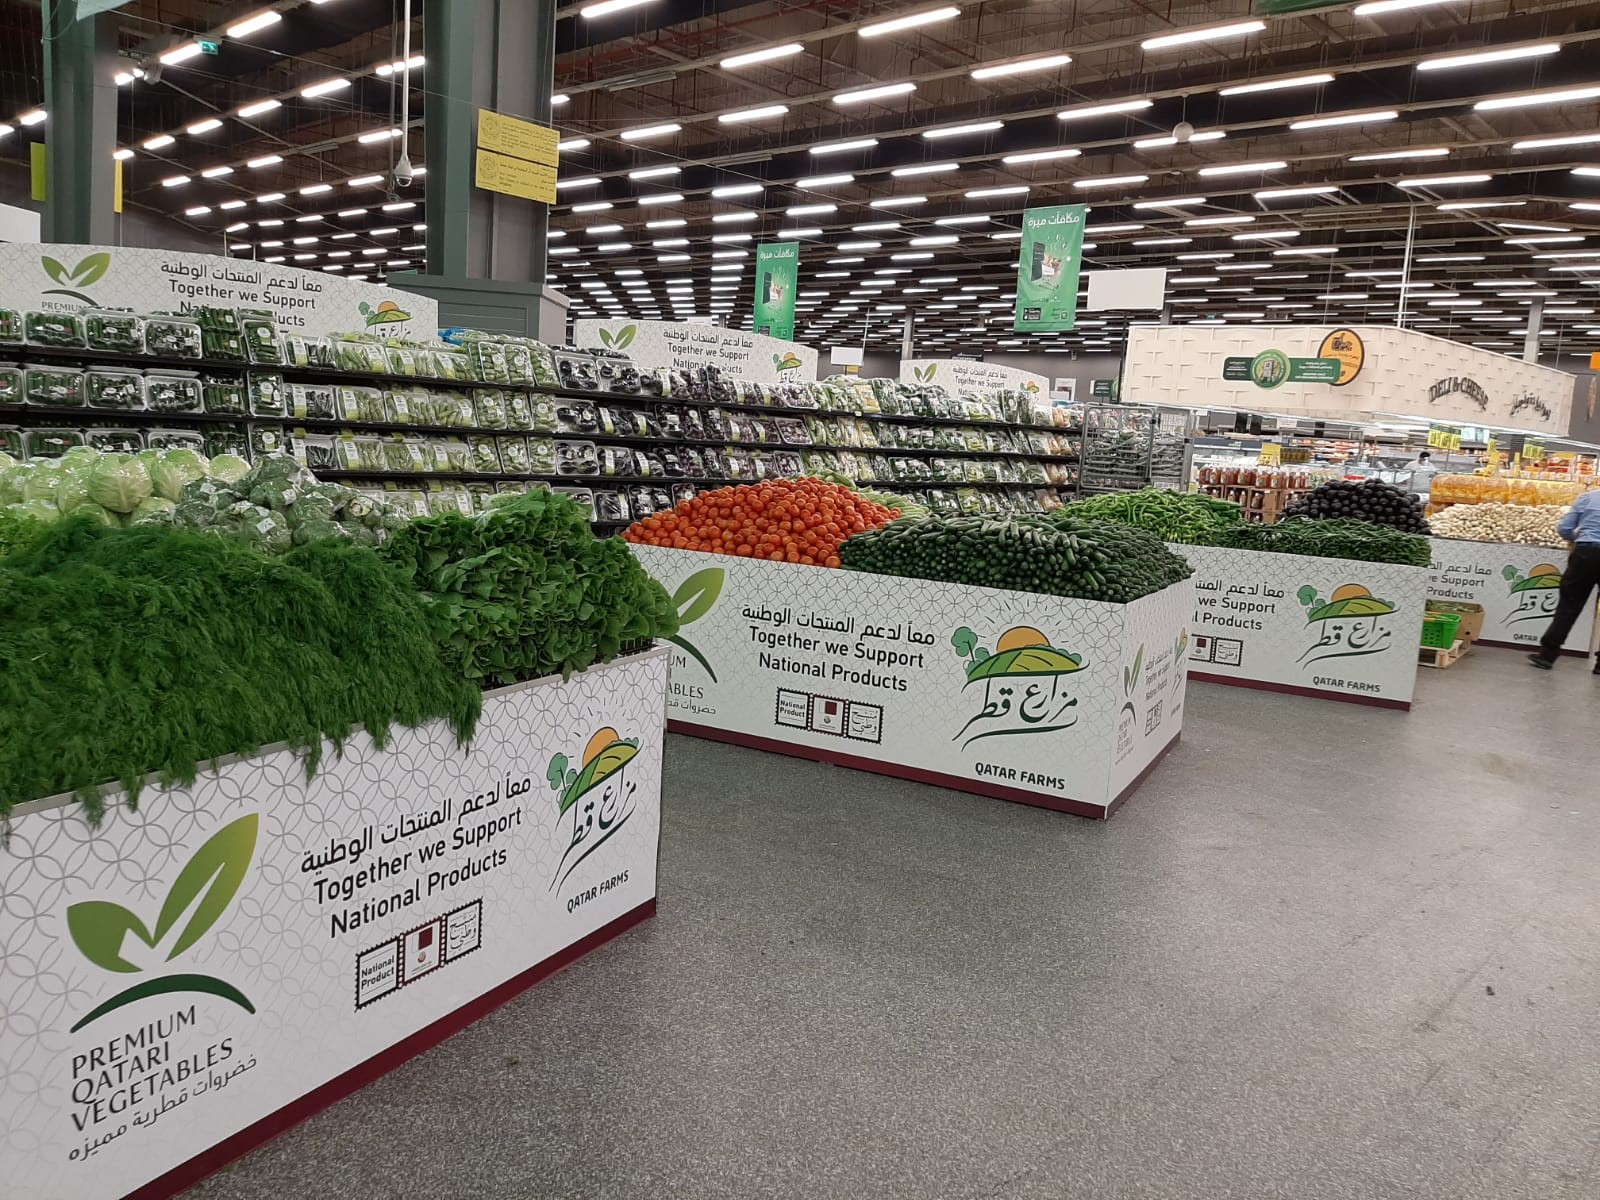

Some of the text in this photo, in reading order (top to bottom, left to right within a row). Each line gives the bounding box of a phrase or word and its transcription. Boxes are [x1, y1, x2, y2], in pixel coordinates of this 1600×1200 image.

[161, 261, 207, 280] الوطنية
[212, 267, 261, 285] المنتجات
[168, 279, 316, 310] Together we Support
[267, 277, 297, 290] لدعم
[667, 342, 749, 361] Together we Support
[1428, 377, 1452, 404] DELI
[1453, 376, 1460, 392] &
[1460, 376, 1488, 412] CHEESE
[1226, 584, 1259, 596] لدعم
[1441, 574, 1485, 588] Support
[742, 604, 791, 627] الوطنية
[1198, 596, 1276, 614] we Support
[796, 611, 855, 634] المنتجات
[860, 623, 901, 641] لدعم
[1202, 612, 1263, 630] Products
[749, 625, 924, 668] Together we Support
[1513, 633, 1539, 642] QATAR
[759, 652, 908, 692] National Products
[1312, 676, 1382, 693] QATAR FARMS
[779, 706, 806, 718] Product
[780, 699, 806, 711] National
[975, 762, 1065, 790] QATAR FARMS
[457, 781, 501, 825] لدعم
[380, 797, 452, 844] المنتجات
[300, 825, 373, 876] الوطنية
[313, 806, 523, 905] Together we Support
[330, 849, 507, 939] National Products
[567, 869, 629, 914] QATAR FARMS
[361, 955, 395, 978] National
[361, 967, 395, 990] Product
[72, 1004, 196, 1080] PREMIUM
[71, 1040, 169, 1105] QATARI
[192, 1054, 257, 1097] خضروات
[70, 1037, 233, 1132] VEGETABLES
[132, 1088, 189, 1128] قطرية
